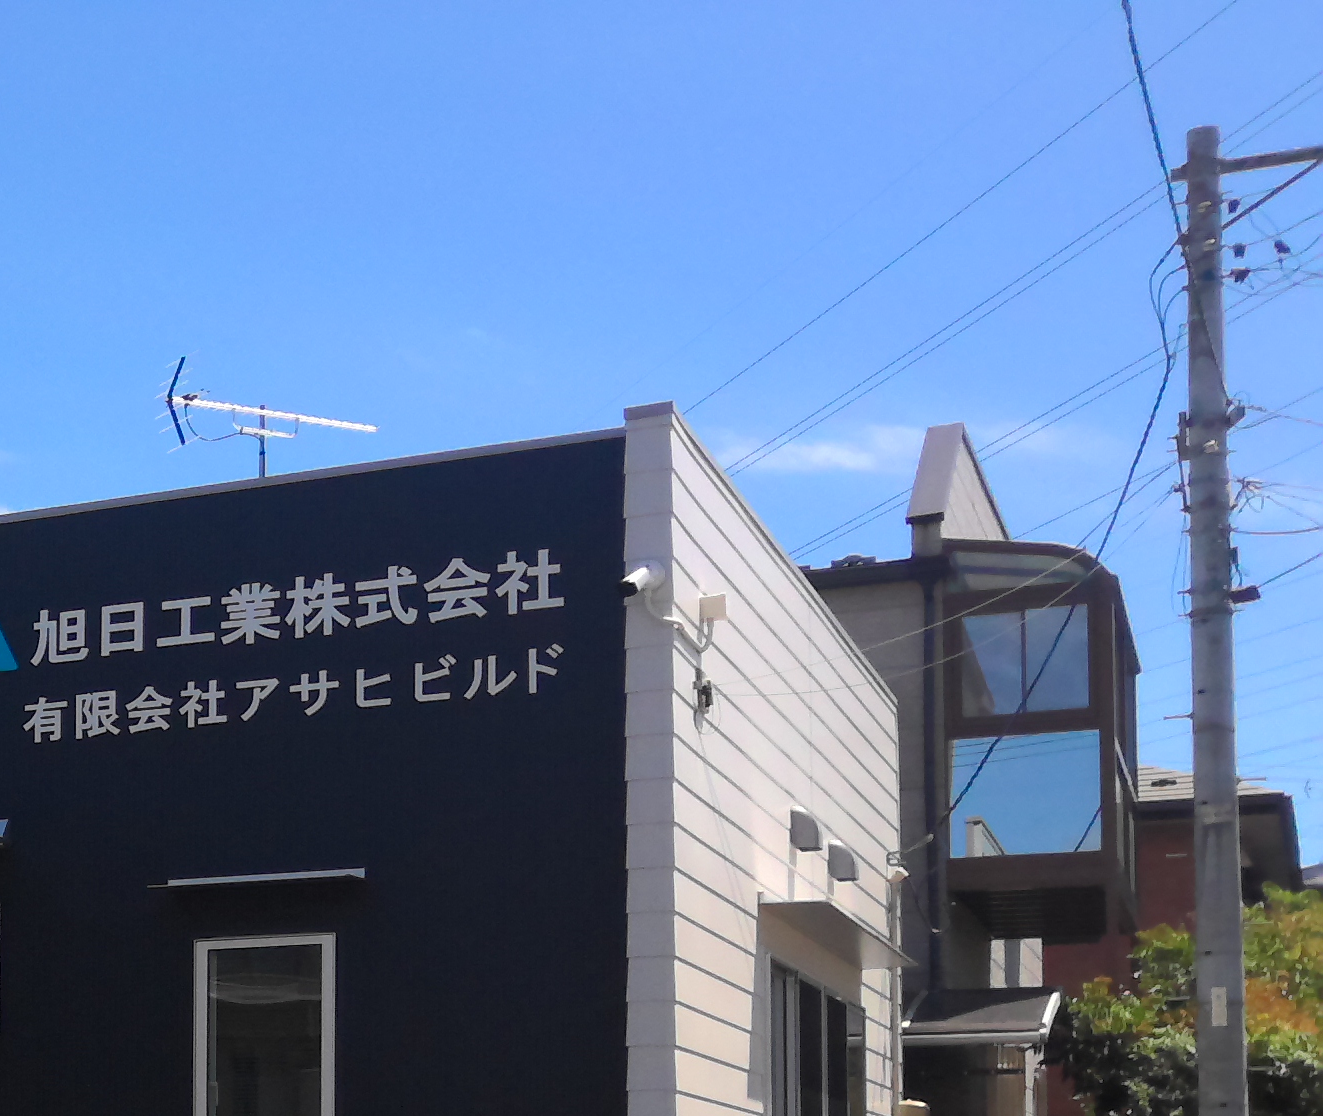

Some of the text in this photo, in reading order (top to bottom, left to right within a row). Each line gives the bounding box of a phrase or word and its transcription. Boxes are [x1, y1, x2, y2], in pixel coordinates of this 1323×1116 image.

[30, 548, 565, 667] 旭日工業株式会社
[22, 644, 565, 744] 有限会社アサヒビルド
